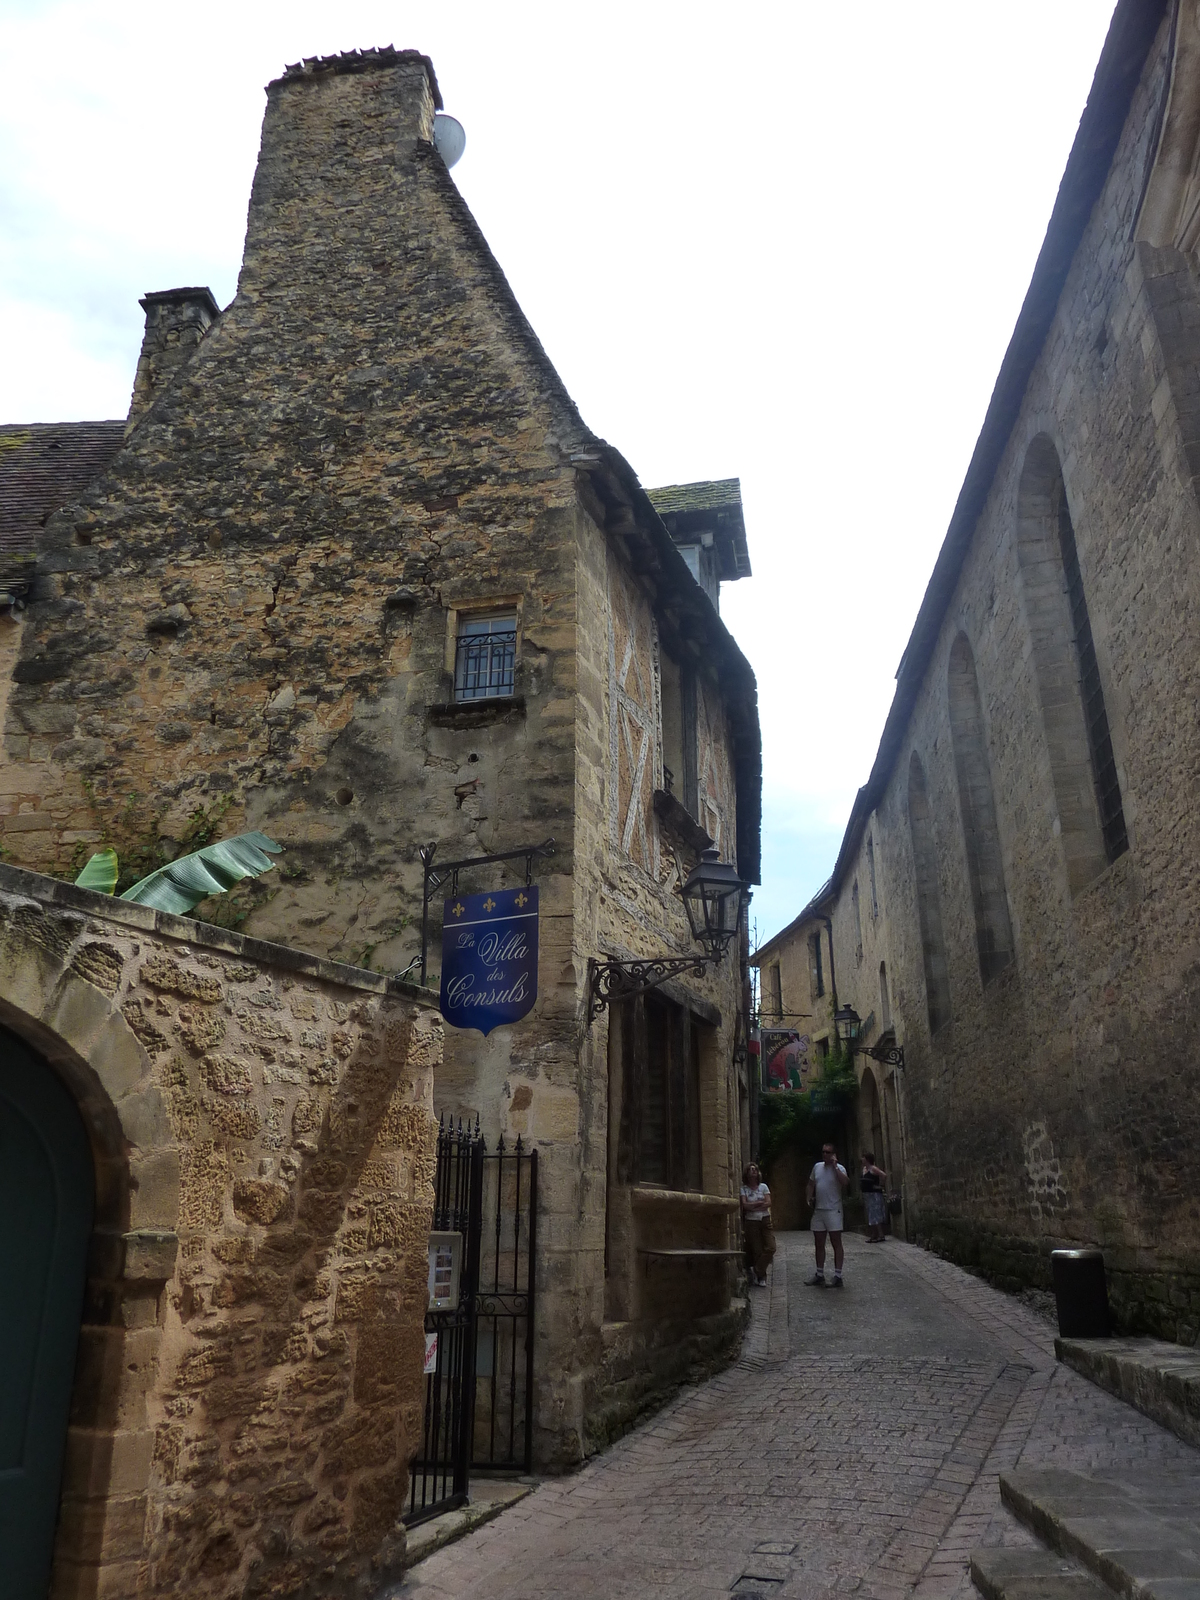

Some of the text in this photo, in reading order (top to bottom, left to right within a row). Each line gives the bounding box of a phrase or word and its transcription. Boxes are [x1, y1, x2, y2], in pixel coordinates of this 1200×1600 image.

[456, 930, 529, 967] La Villa
[447, 971, 529, 1009] Consuls
[486, 967, 506, 982] des
